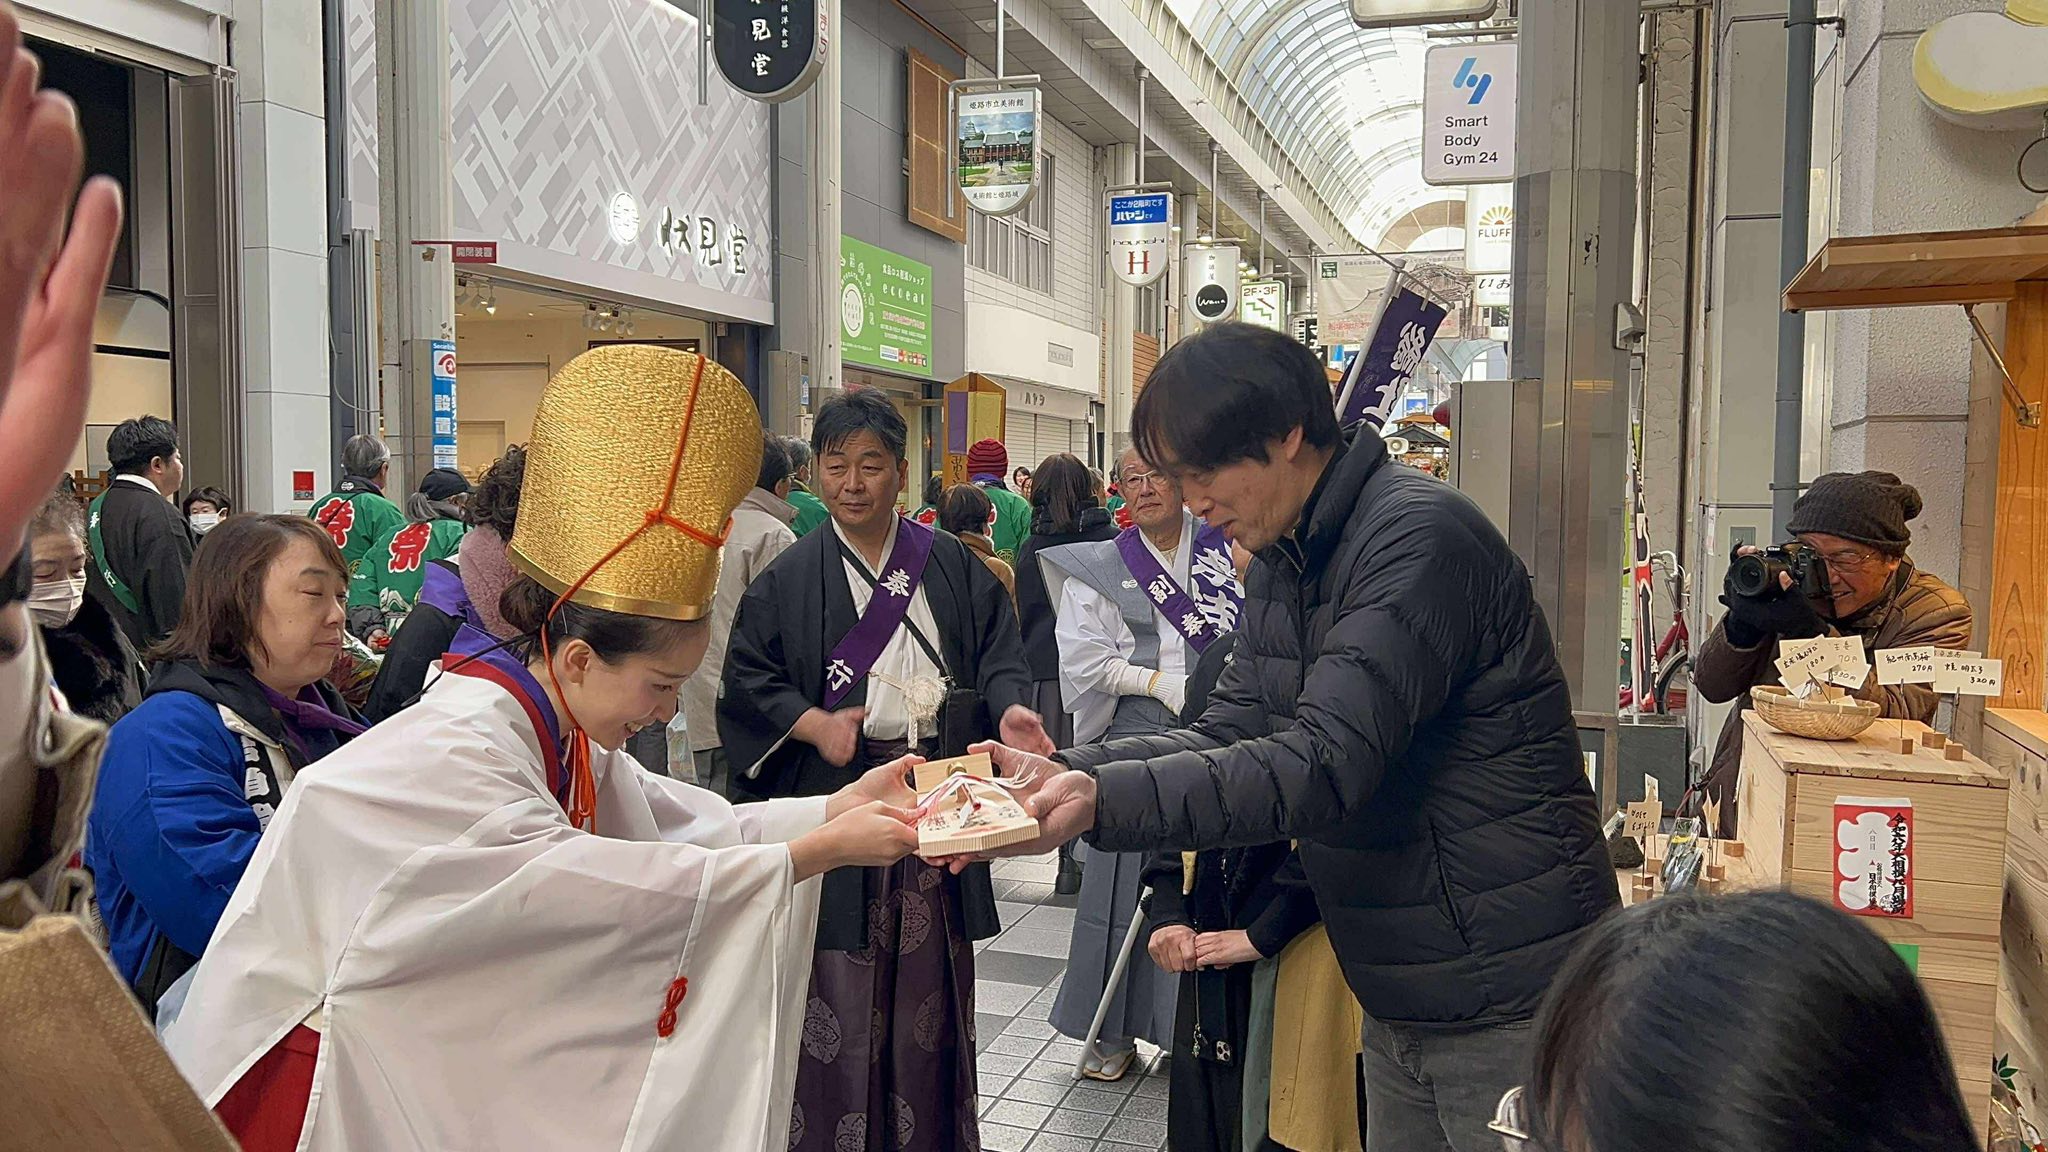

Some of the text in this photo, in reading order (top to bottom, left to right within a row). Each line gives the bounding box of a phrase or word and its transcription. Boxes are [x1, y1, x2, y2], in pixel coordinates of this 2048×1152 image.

[781, 0, 789, 48] 級洋食器
[750, 0, 771, 76] 見堂
[969, 98, 1024, 110] 姫路市立美術館
[1445, 115, 1488, 128] Smart
[1445, 134, 1481, 147] Body
[1444, 152, 1498, 166] Gym 24
[658, 205, 748, 274] 伏見堂
[1911, 664, 1933, 672] 270円
[1969, 676, 1996, 687] 320円
